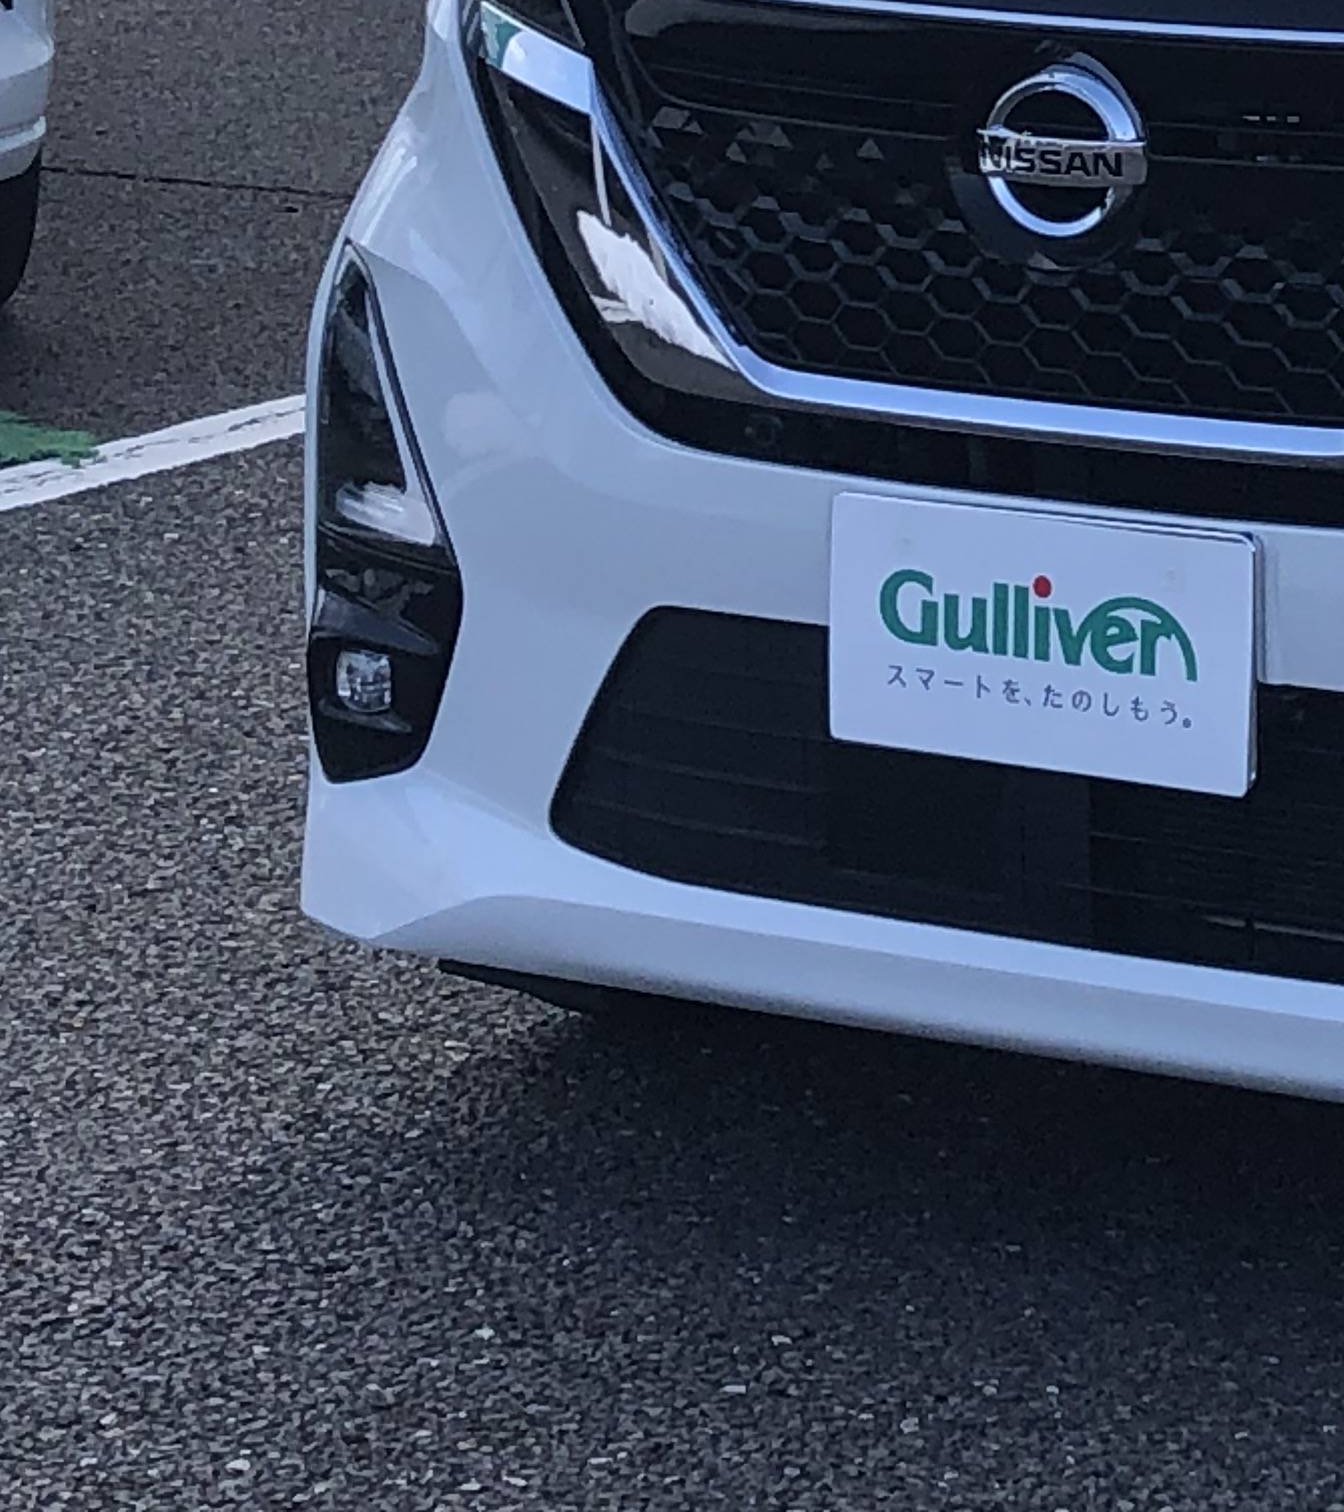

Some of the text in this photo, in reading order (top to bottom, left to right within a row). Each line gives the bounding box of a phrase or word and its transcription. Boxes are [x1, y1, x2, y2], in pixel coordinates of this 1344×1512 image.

[980, 136, 1124, 178] NISSAN
[879, 568, 1198, 682] Gulliver
[886, 664, 1193, 730] スマートを、たのしもう。
